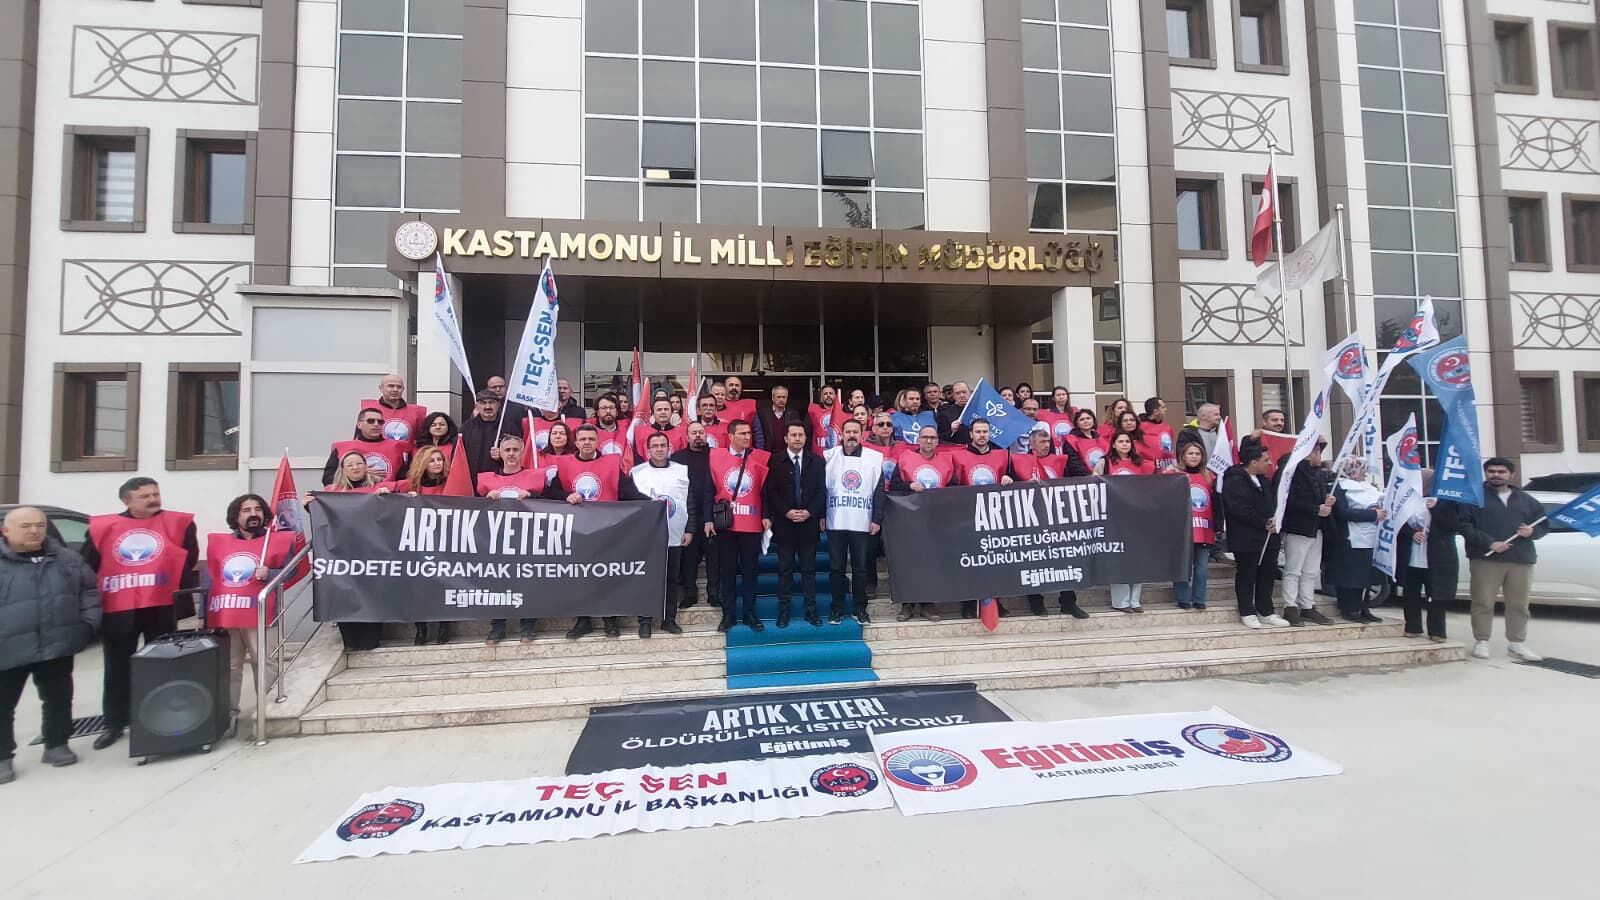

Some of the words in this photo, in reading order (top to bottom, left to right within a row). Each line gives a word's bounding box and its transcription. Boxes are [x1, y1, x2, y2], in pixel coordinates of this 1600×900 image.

[443, 228, 662, 262] KASTAMONU
[673, 231, 702, 264] İL
[804, 235, 909, 270] EĞİTİM
[918, 238, 1104, 273] MÜDÜRLÜĞÜ
[522, 311, 553, 387] TEÇ-SEN
[974, 490, 1039, 532] ARTIK
[1043, 482, 1108, 526] YETER!
[399, 508, 480, 553] ARTIK
[488, 511, 574, 556] YETER!
[980, 532, 1033, 551] ŞİDDETE
[1034, 527, 1091, 547] UĞRAMAK
[313, 557, 402, 580] ŞİDDETE
[406, 555, 511, 579] UĞRAMAK
[516, 560, 646, 579] İSTEMİYORUZ
[960, 546, 1047, 568] ÖLDÜRÜLMEK
[1048, 542, 1125, 561] İSTEMİYORUZ!
[1020, 565, 1083, 588] Eğitimiş
[445, 588, 523, 609] Eğitimiş
[703, 703, 785, 731] ARTIK
[791, 697, 889, 722] YETER!
[621, 723, 802, 751] ÖLDÜRÜLMEK
[759, 738, 850, 755] Eğitimiş
[980, 737, 1186, 771] Eğitimiş
[1035, 765, 1126, 780] KASTAMONU
[1129, 759, 1177, 775] ŞUBESİ
[536, 782, 627, 803] TEÇ
[639, 771, 728, 794] SEN
[419, 801, 606, 832] KASTAMONU
[614, 797, 637, 815] İL
[645, 785, 810, 812] BAŞKANLIĞI
